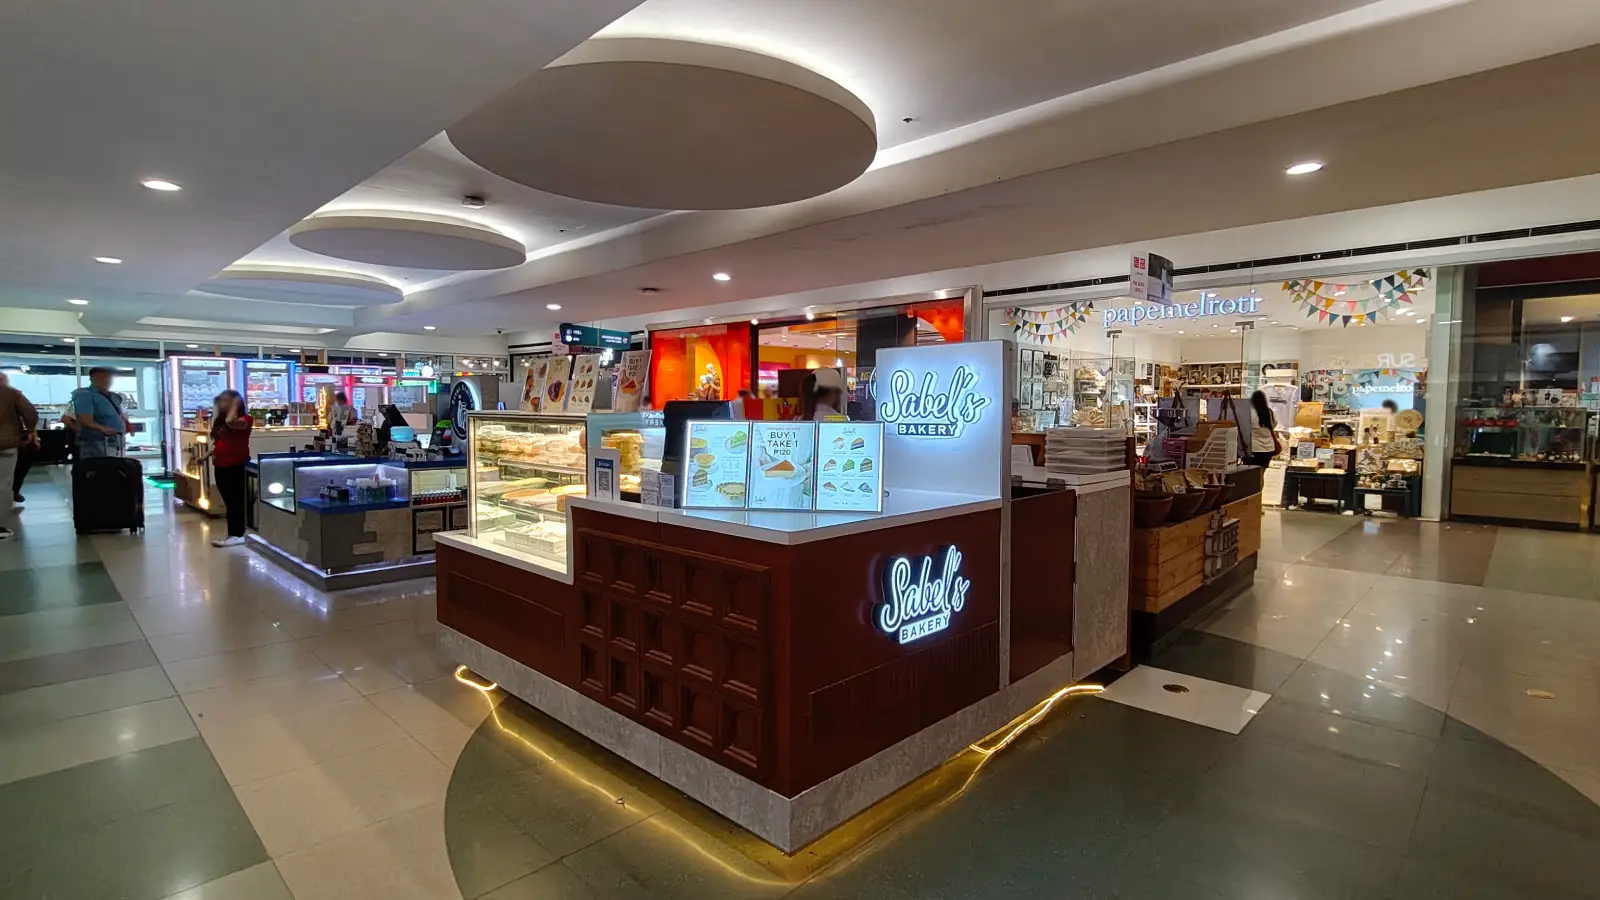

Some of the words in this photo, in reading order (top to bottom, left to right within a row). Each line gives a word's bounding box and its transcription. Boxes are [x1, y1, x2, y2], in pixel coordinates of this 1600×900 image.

[1103, 288, 1257, 328] papemelroti
[880, 365, 987, 424] Sabel's
[770, 431, 789, 439] BUY
[792, 431, 796, 439] 1
[898, 423, 957, 436] BAKERY
[767, 440, 792, 448] TAKE
[794, 440, 798, 448] 1
[880, 544, 971, 633] Sabel's
[901, 613, 950, 641] BAKERY
